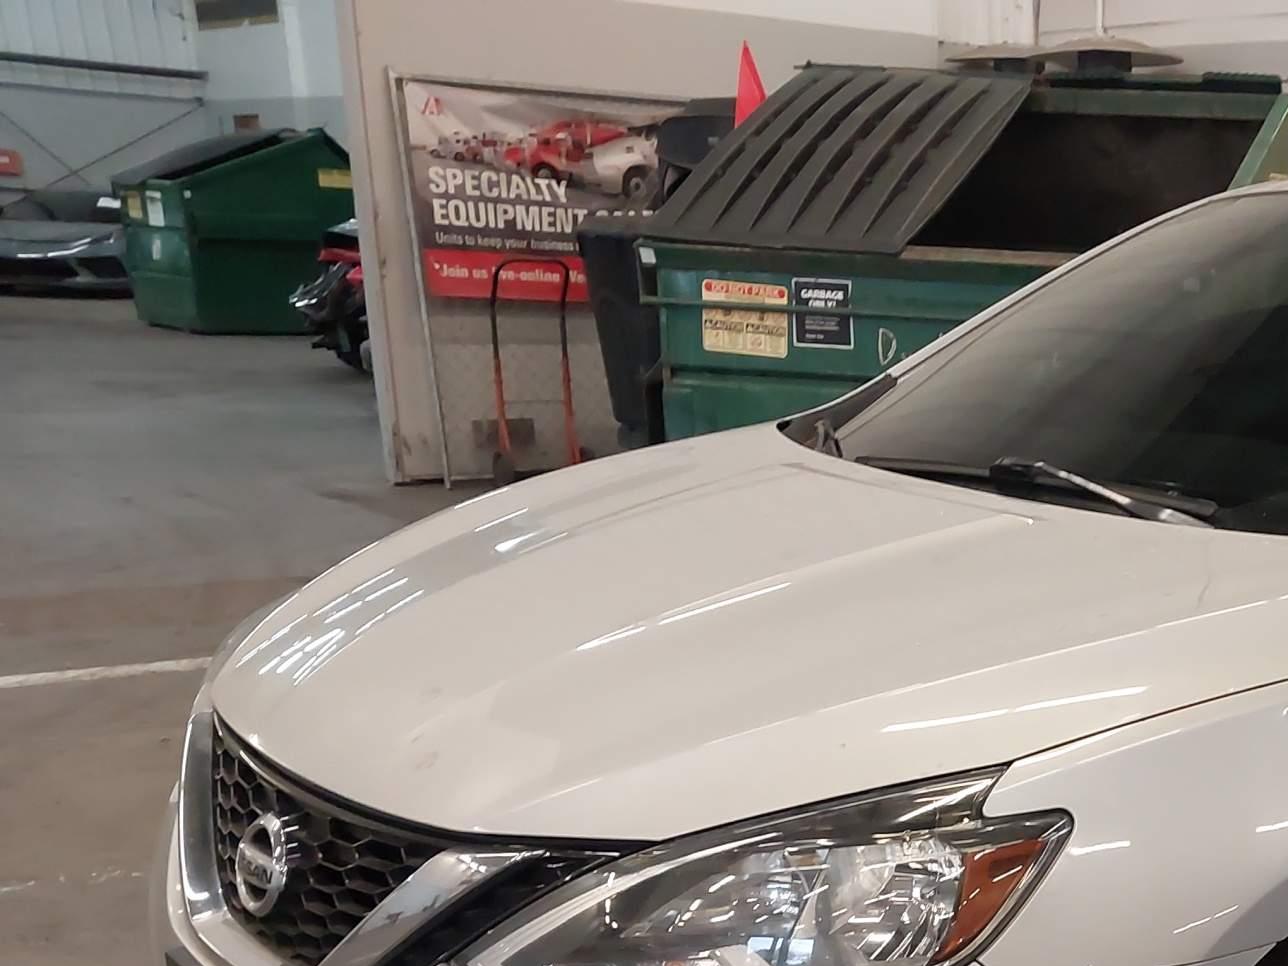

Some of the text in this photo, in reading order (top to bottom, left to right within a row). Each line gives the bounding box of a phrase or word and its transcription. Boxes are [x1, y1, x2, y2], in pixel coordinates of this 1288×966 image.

[428, 166, 567, 203] SPECIALTY
[432, 198, 588, 234] EQUIPMENT
[435, 231, 463, 246] Units
[465, 234, 475, 247] to
[477, 235, 502, 250] keep
[505, 238, 528, 250] your
[440, 263, 468, 279] Join
[472, 267, 488, 279] us
[800, 288, 844, 300] GARBAGE
